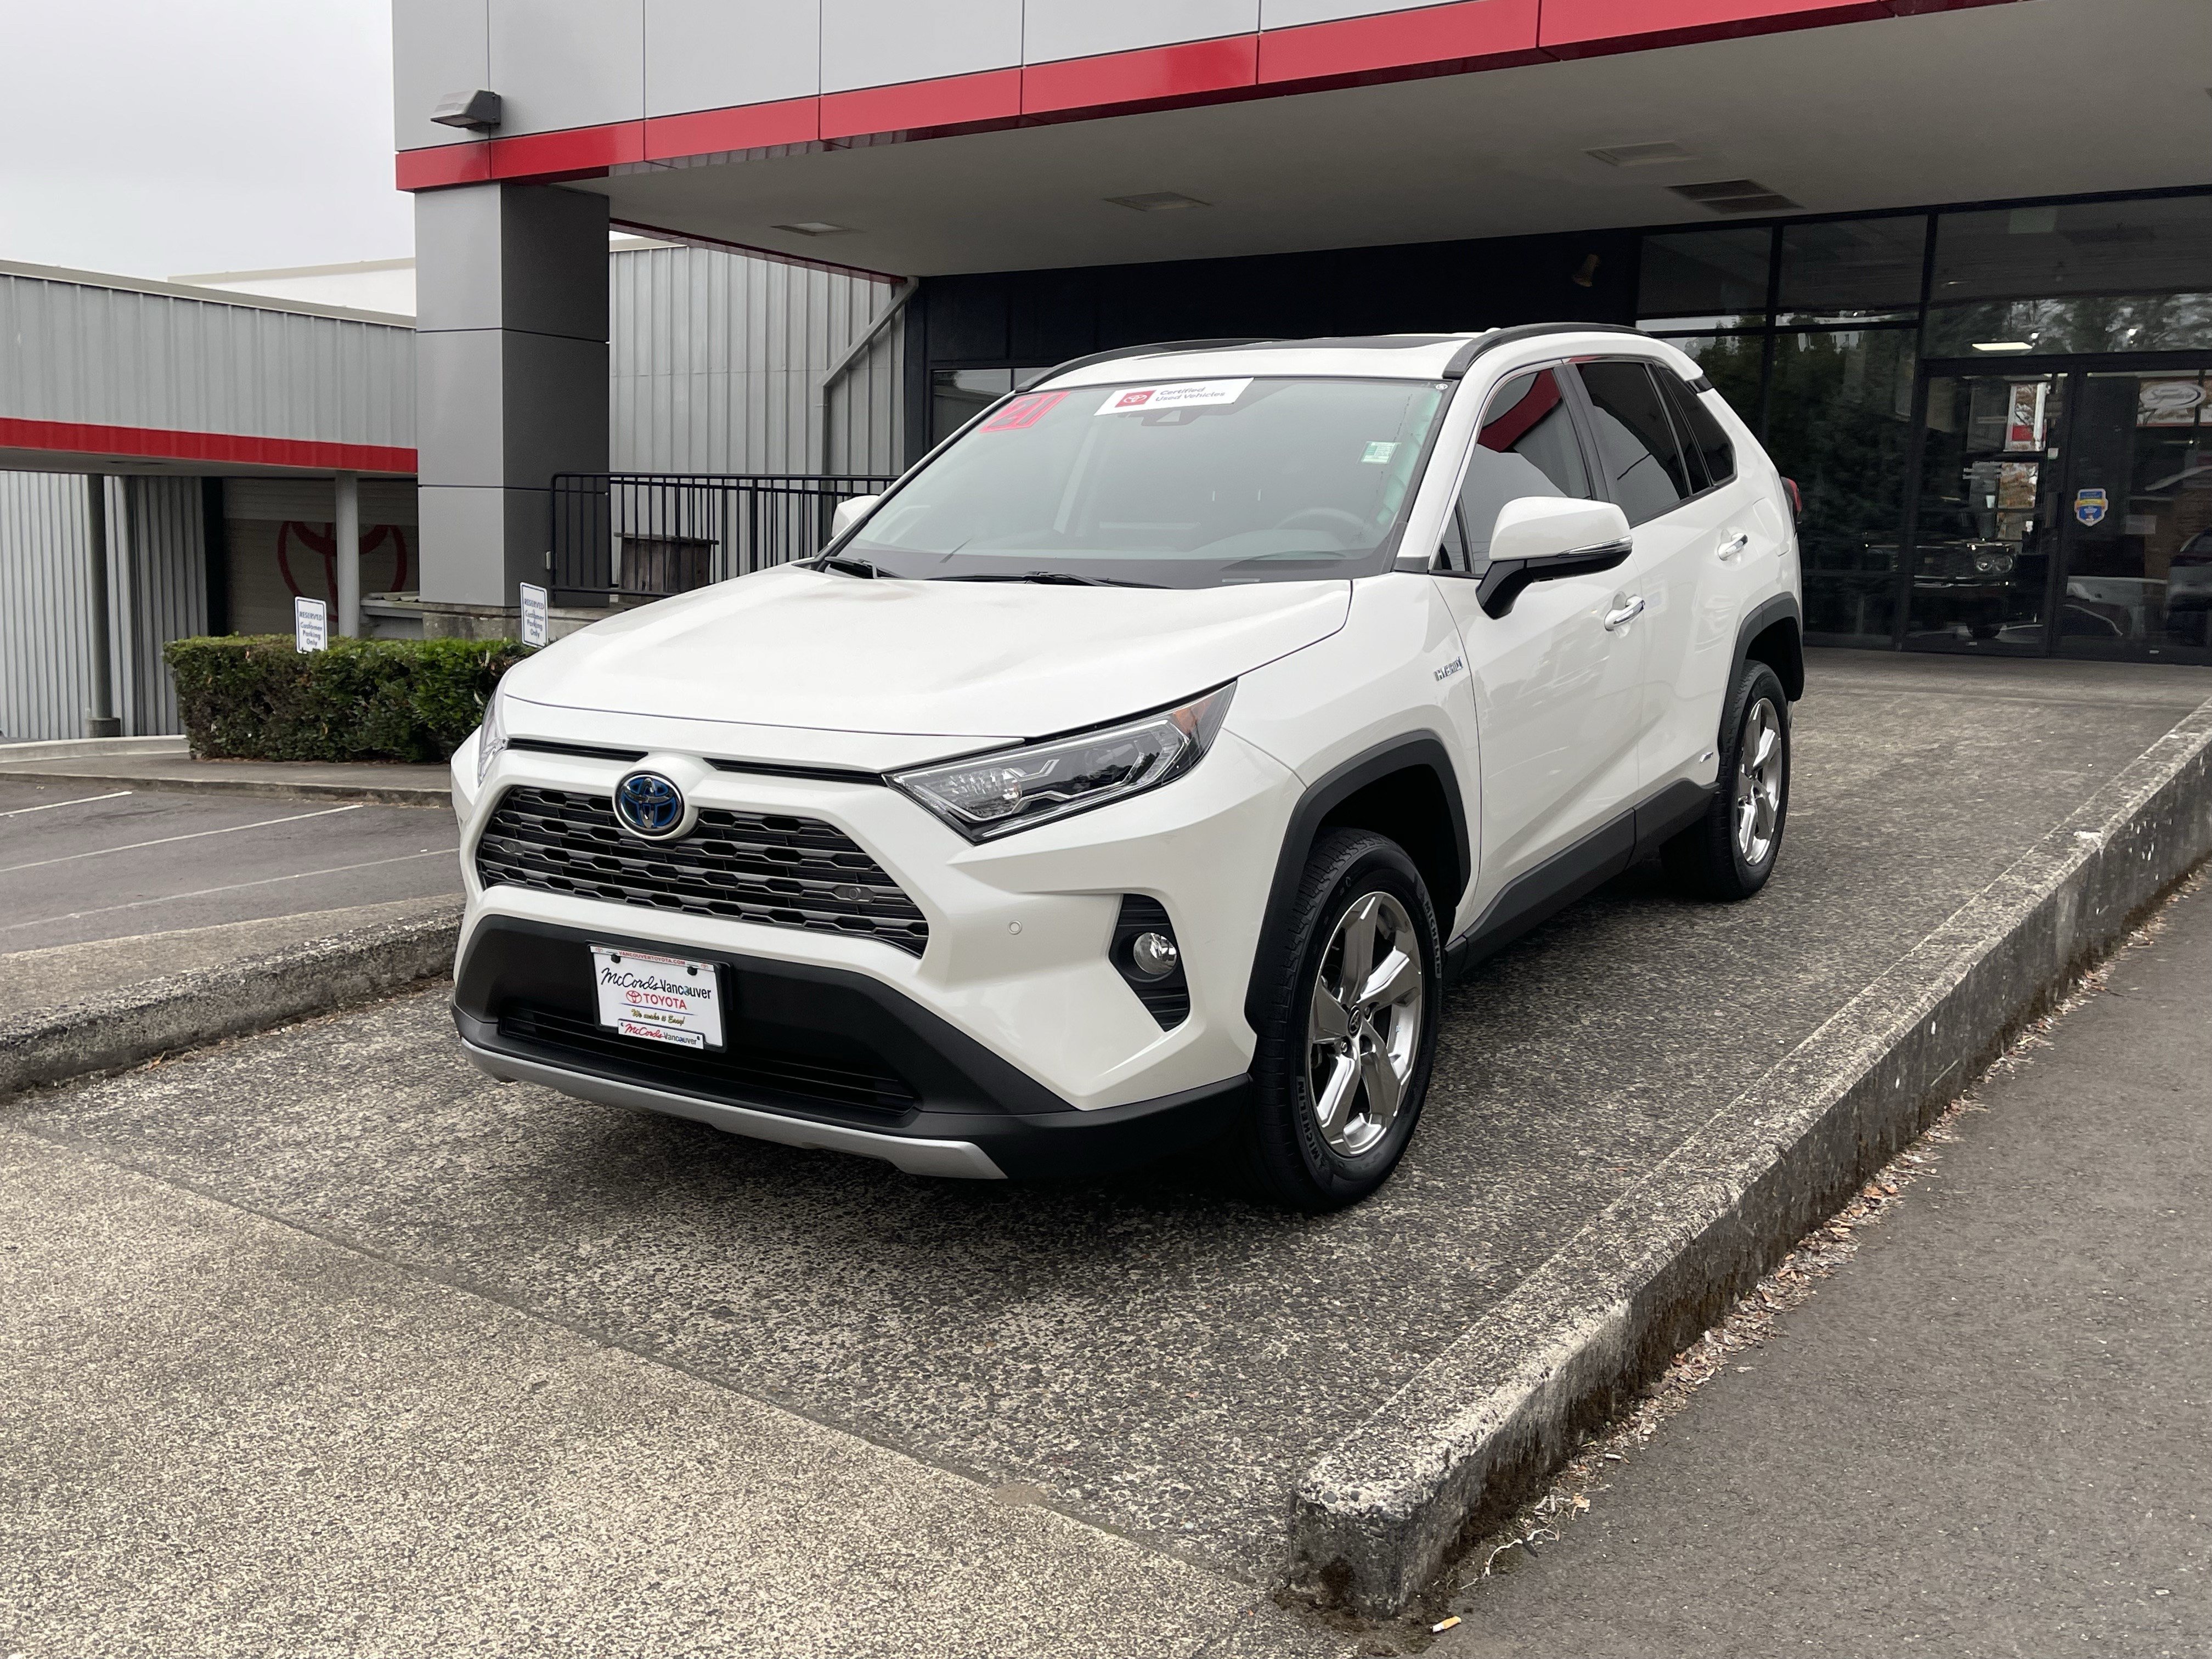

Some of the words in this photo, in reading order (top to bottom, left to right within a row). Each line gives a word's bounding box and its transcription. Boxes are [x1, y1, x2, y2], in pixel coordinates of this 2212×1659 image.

[1160, 387, 1206, 395] Certified
[984, 392, 1066, 430] 21
[524, 599, 545, 610] RESERVED
[299, 611, 324, 621] RESERVED
[300, 622, 323, 631] Customer
[303, 630, 321, 641] Parking
[530, 628, 540, 639] Only
[306, 638, 318, 647] Only
[1434, 656, 1463, 681] HYBRID
[1425, 900, 1441, 975] MICHELIN
[618, 951, 686, 965] VANCOUVERTOYOTA.COM
[643, 993, 687, 1010] TOYOTA
[631, 1008, 642, 1018] We
[668, 1014, 686, 1026] Easy!
[1297, 1080, 1321, 1161] MICHELIN
